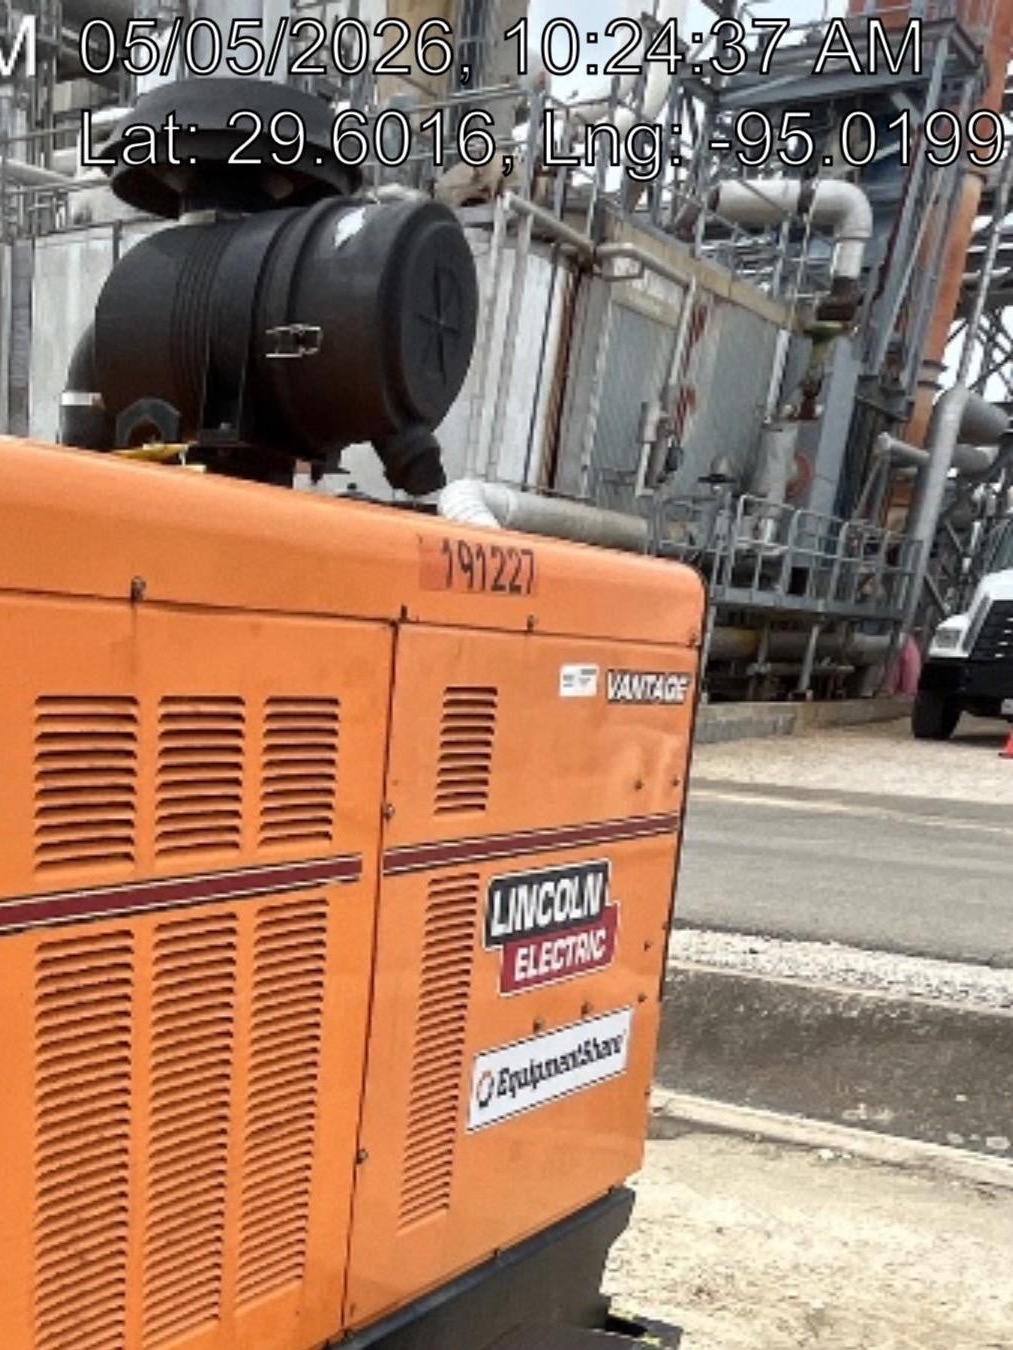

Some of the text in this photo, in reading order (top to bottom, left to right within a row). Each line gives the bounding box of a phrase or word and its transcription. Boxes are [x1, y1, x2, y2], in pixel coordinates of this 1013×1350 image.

[441, 538, 535, 595] 191227
[607, 669, 690, 703] VANTAGE
[490, 871, 605, 937] LINCOLN
[513, 927, 608, 982] ELECTRIC
